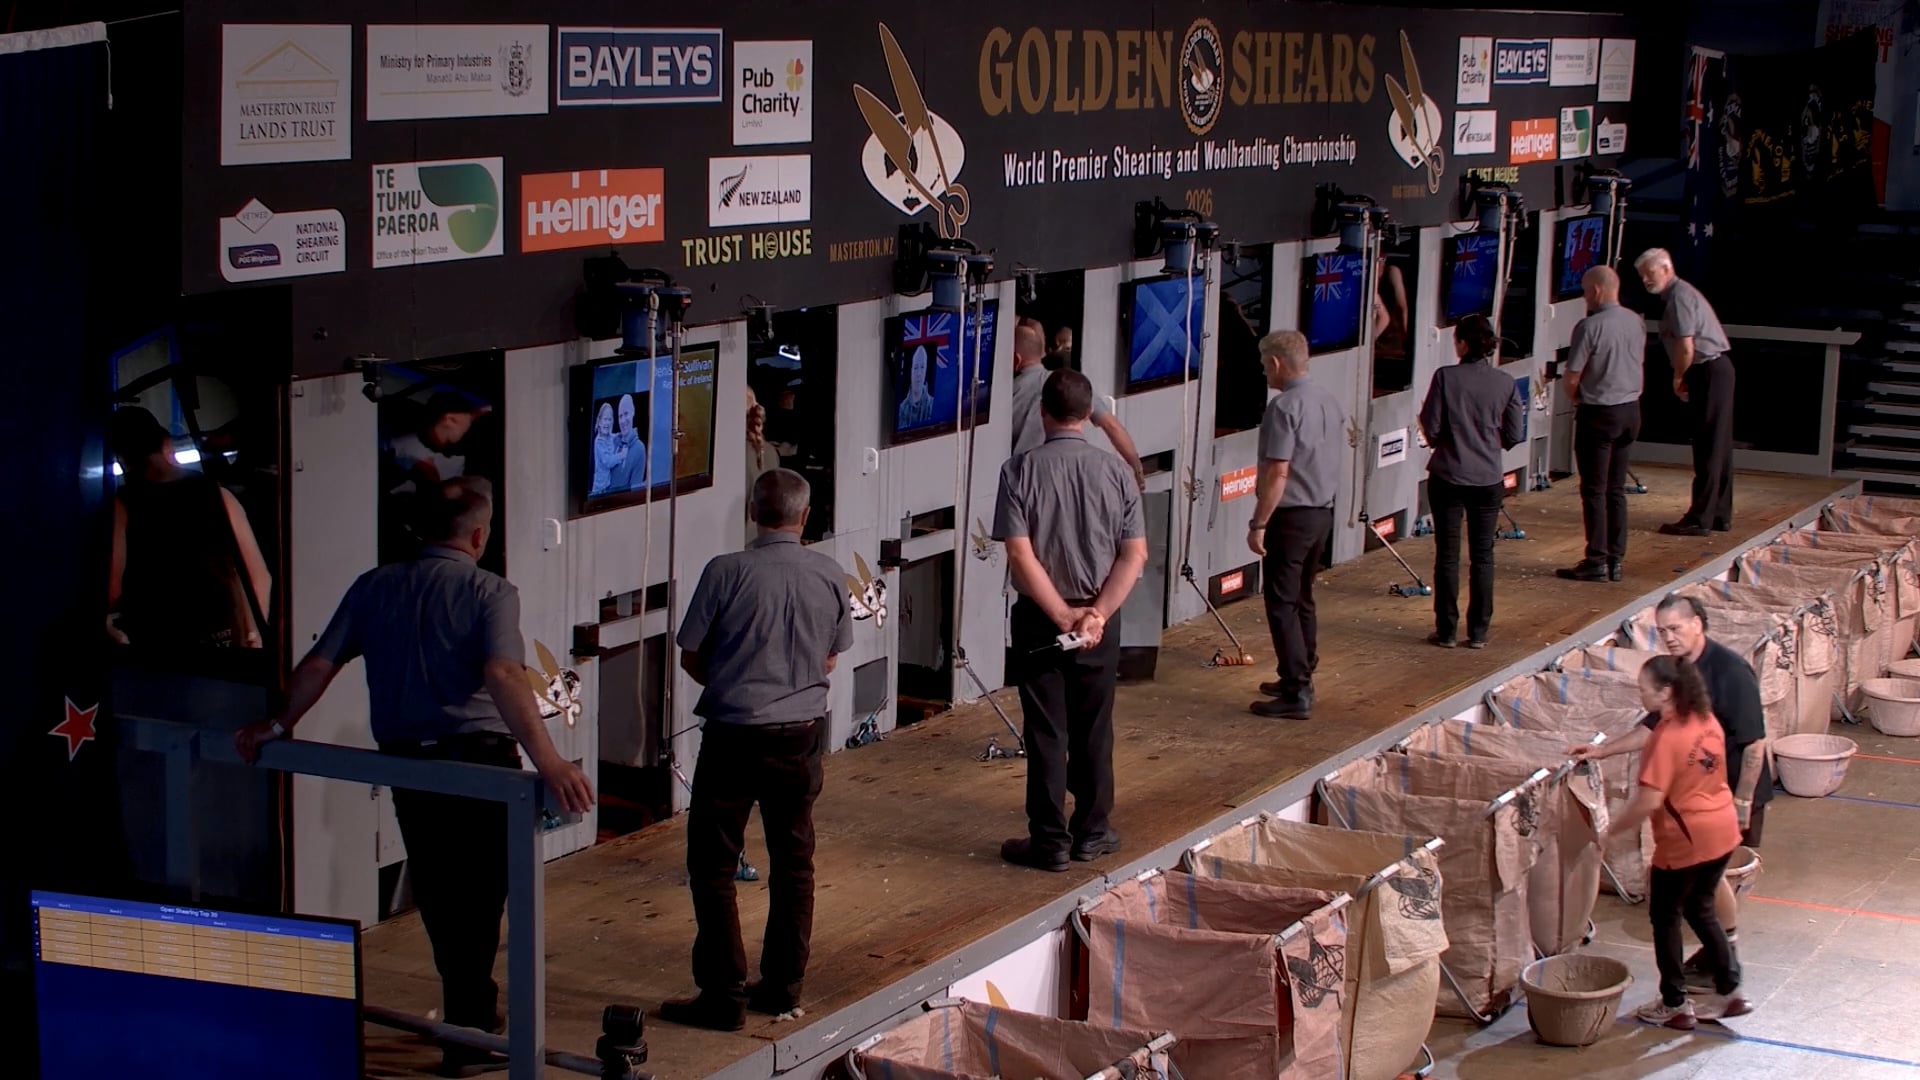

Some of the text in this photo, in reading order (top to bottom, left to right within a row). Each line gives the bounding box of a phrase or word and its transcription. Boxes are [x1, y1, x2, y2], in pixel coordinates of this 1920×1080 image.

[380, 53, 492, 71] Ministry for Primary Industries
[569, 45, 713, 87] BAYLEYS
[1462, 54, 1476, 67] Pub
[1498, 49, 1546, 73] BAYLEYS
[743, 67, 774, 88] Pub
[978, 27, 1376, 117] GOLDEN SHEARS
[1461, 70, 1486, 86] Charity
[240, 101, 336, 116] MASTERTON TRUST
[742, 93, 800, 117] Charity
[240, 120, 335, 139] LANDS TRUST
[1511, 120, 1555, 158] Heiniger
[1004, 133, 1357, 187] World Premier Shearing and Woolhandling Championship
[376, 169, 394, 189] TE
[1467, 167, 1493, 181] TUST
[376, 190, 421, 212] TUMU
[527, 170, 661, 239] Heiniger
[739, 189, 801, 207] NEW ZEALAND
[1186, 188, 1213, 217] 2026
[296, 221, 339, 235] NATIONAL
[377, 212, 439, 236] PAEROA
[296, 235, 339, 249] SHEARING
[682, 229, 812, 267] TRUST HOUSE
[829, 236, 895, 263] MASTERTON.NZ
[296, 250, 330, 263] CIRCUIT
